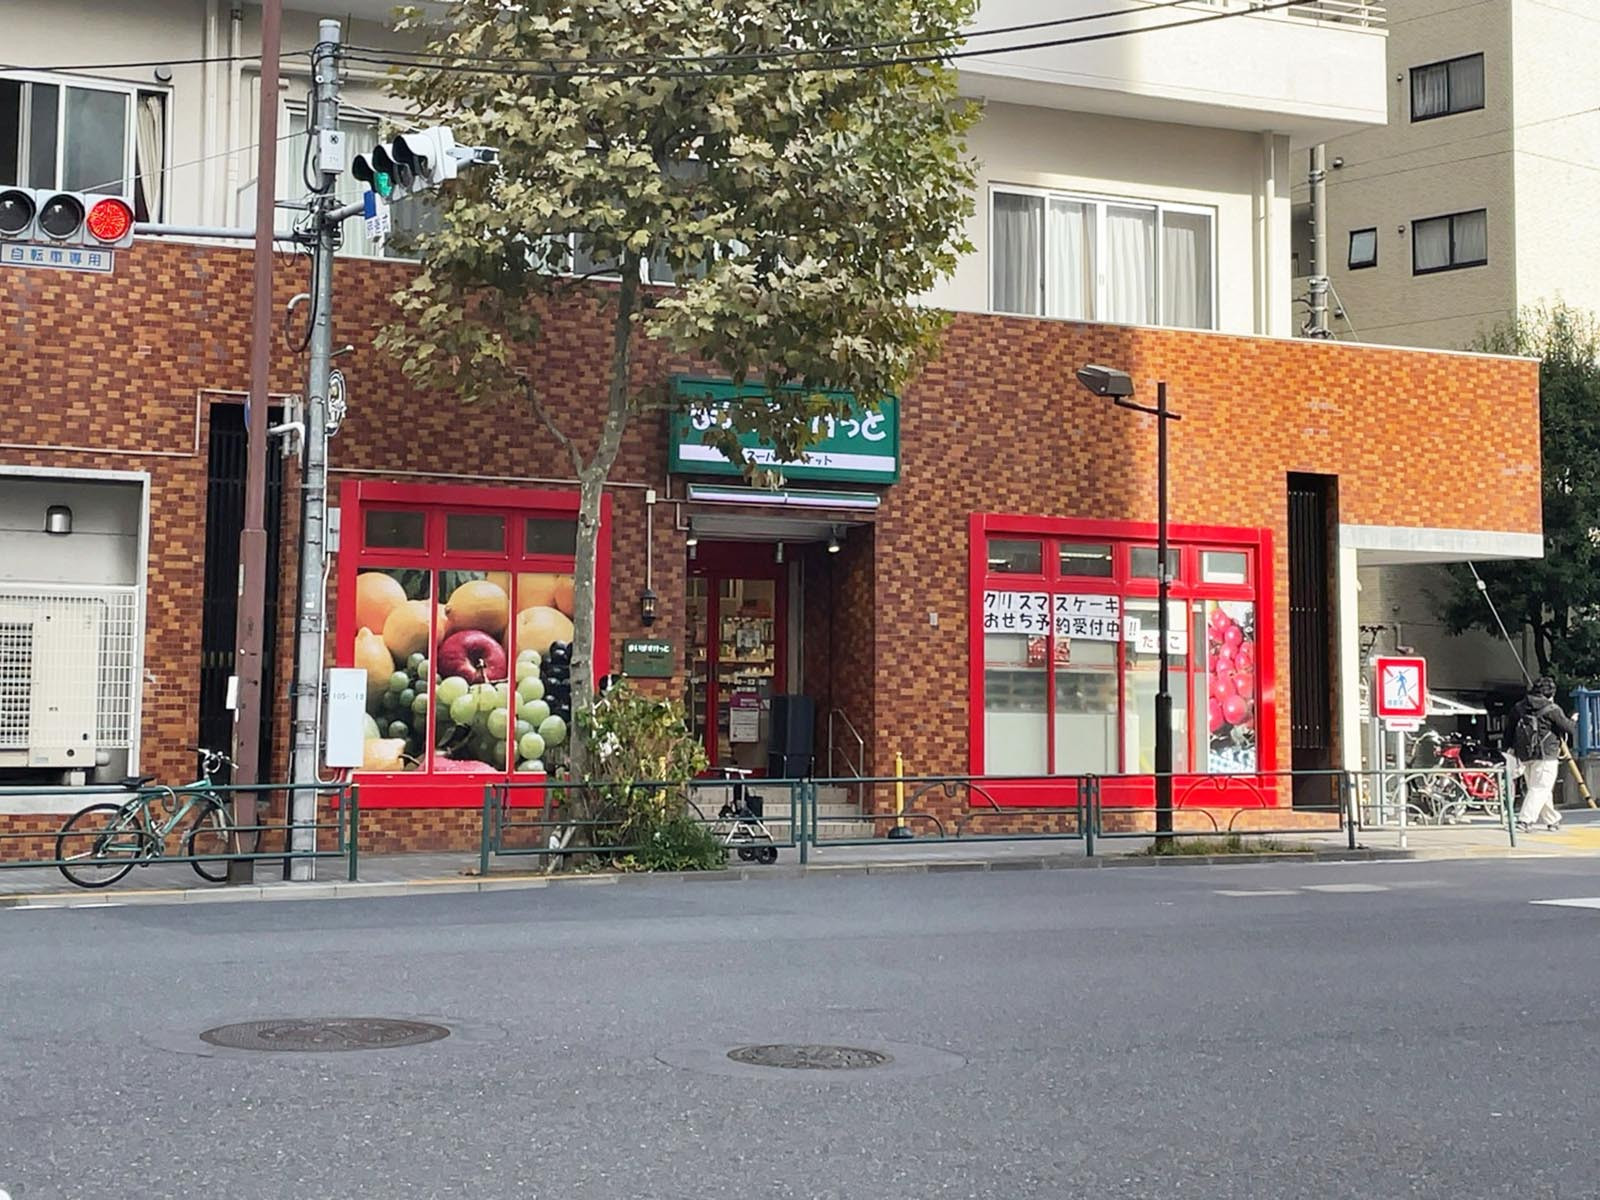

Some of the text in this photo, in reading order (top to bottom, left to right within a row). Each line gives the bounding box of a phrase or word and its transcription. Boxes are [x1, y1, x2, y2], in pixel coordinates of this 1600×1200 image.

[984, 593, 1119, 613] クリスマスケーキ
[1142, 635, 1181, 651] たこ
